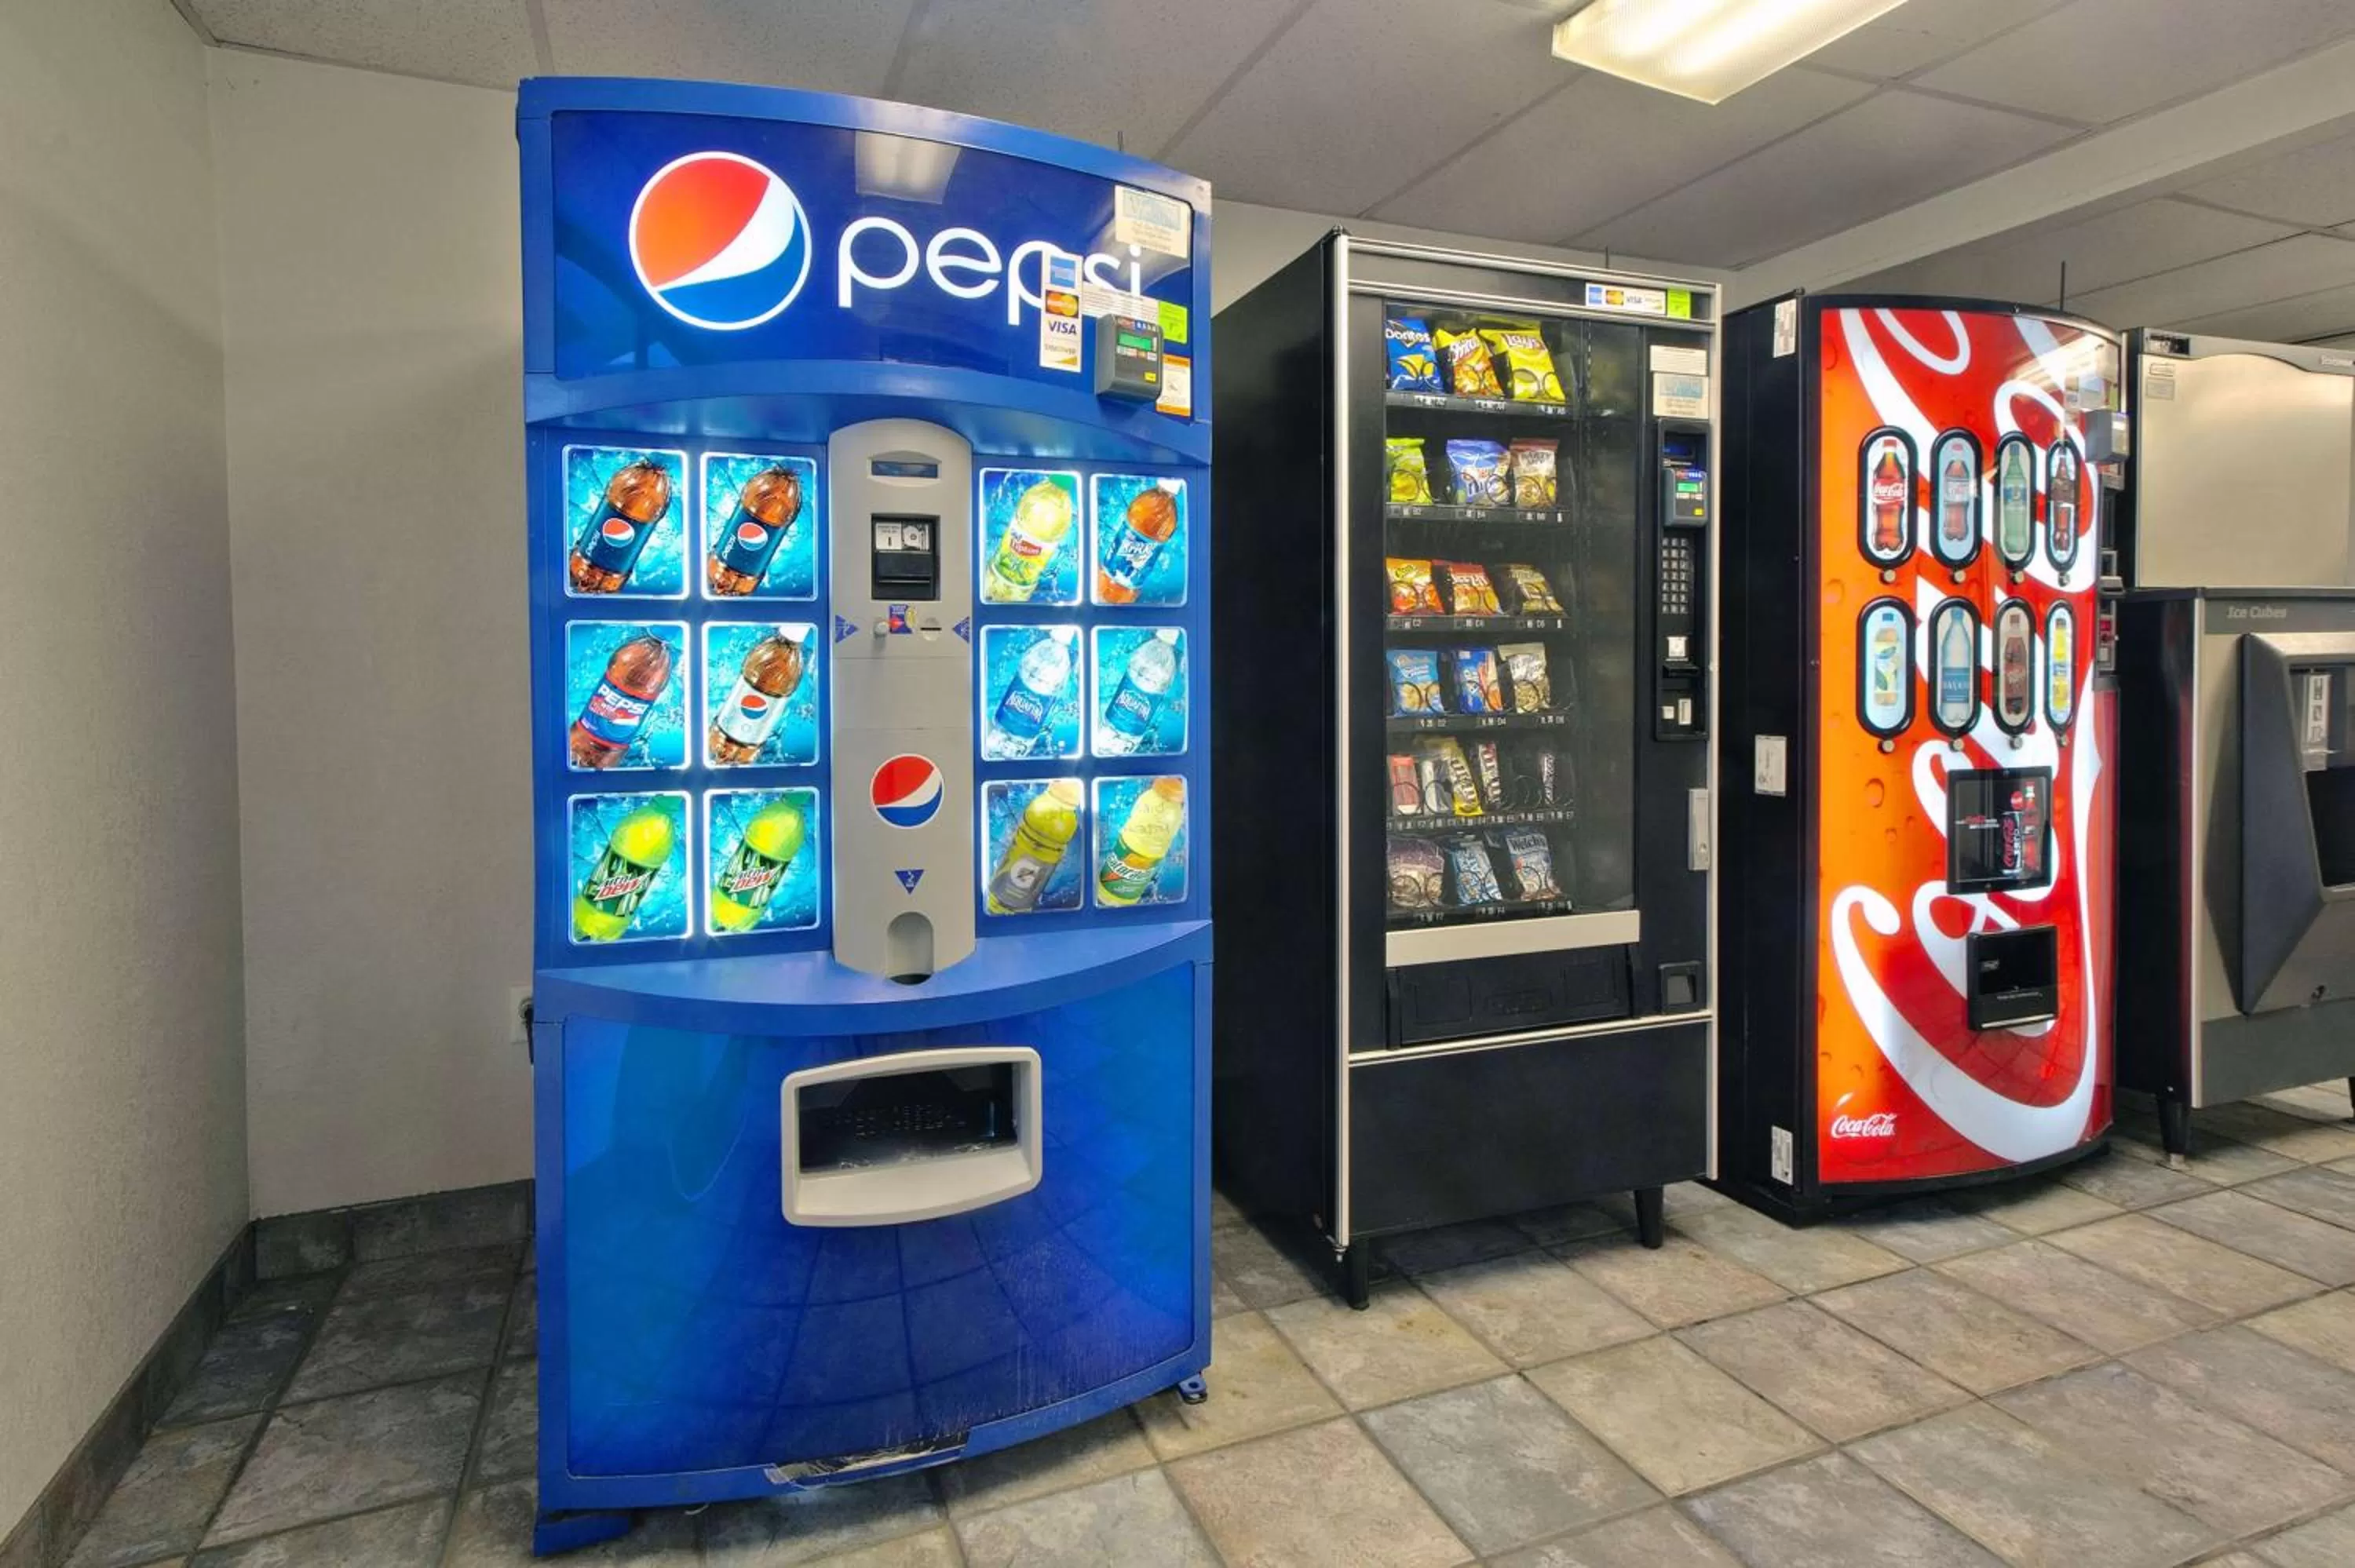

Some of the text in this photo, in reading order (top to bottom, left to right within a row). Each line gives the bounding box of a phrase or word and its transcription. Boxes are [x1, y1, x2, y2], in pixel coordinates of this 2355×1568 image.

[1048, 320, 1078, 336] VISA
[1385, 327, 1431, 343] Doritos
[2226, 603, 2287, 618] Ice Cubes
[598, 683, 649, 715] PEPSI
[1830, 1112, 1897, 1139] Coca-Cola
